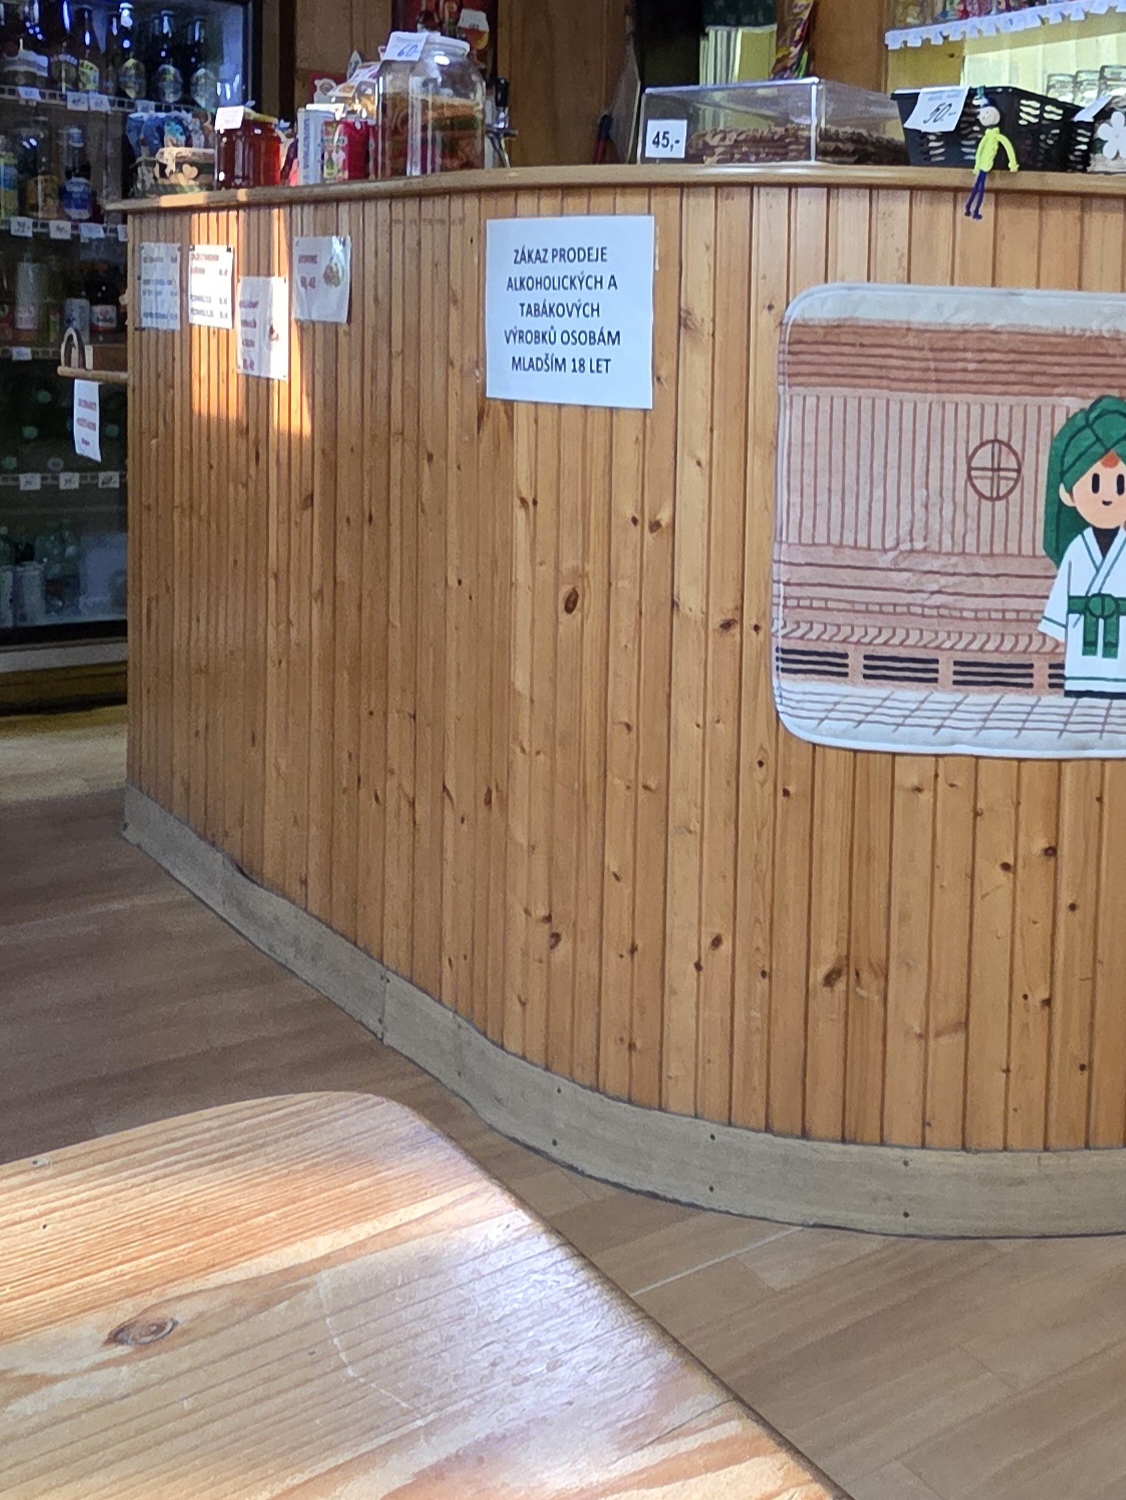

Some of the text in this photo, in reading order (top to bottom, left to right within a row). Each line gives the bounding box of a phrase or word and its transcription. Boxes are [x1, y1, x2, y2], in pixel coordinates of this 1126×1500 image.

[651, 131, 681, 152] 45,-
[514, 245, 608, 265] ZÁKAZ PRODEJE
[506, 271, 618, 291] ALKOHOLICKÝCH A
[519, 299, 601, 318] TABÁKOVÝCH
[504, 325, 621, 346] VÝROBKŮ OSOBÁM
[511, 353, 612, 374] MLADŠÍM 18 LET
